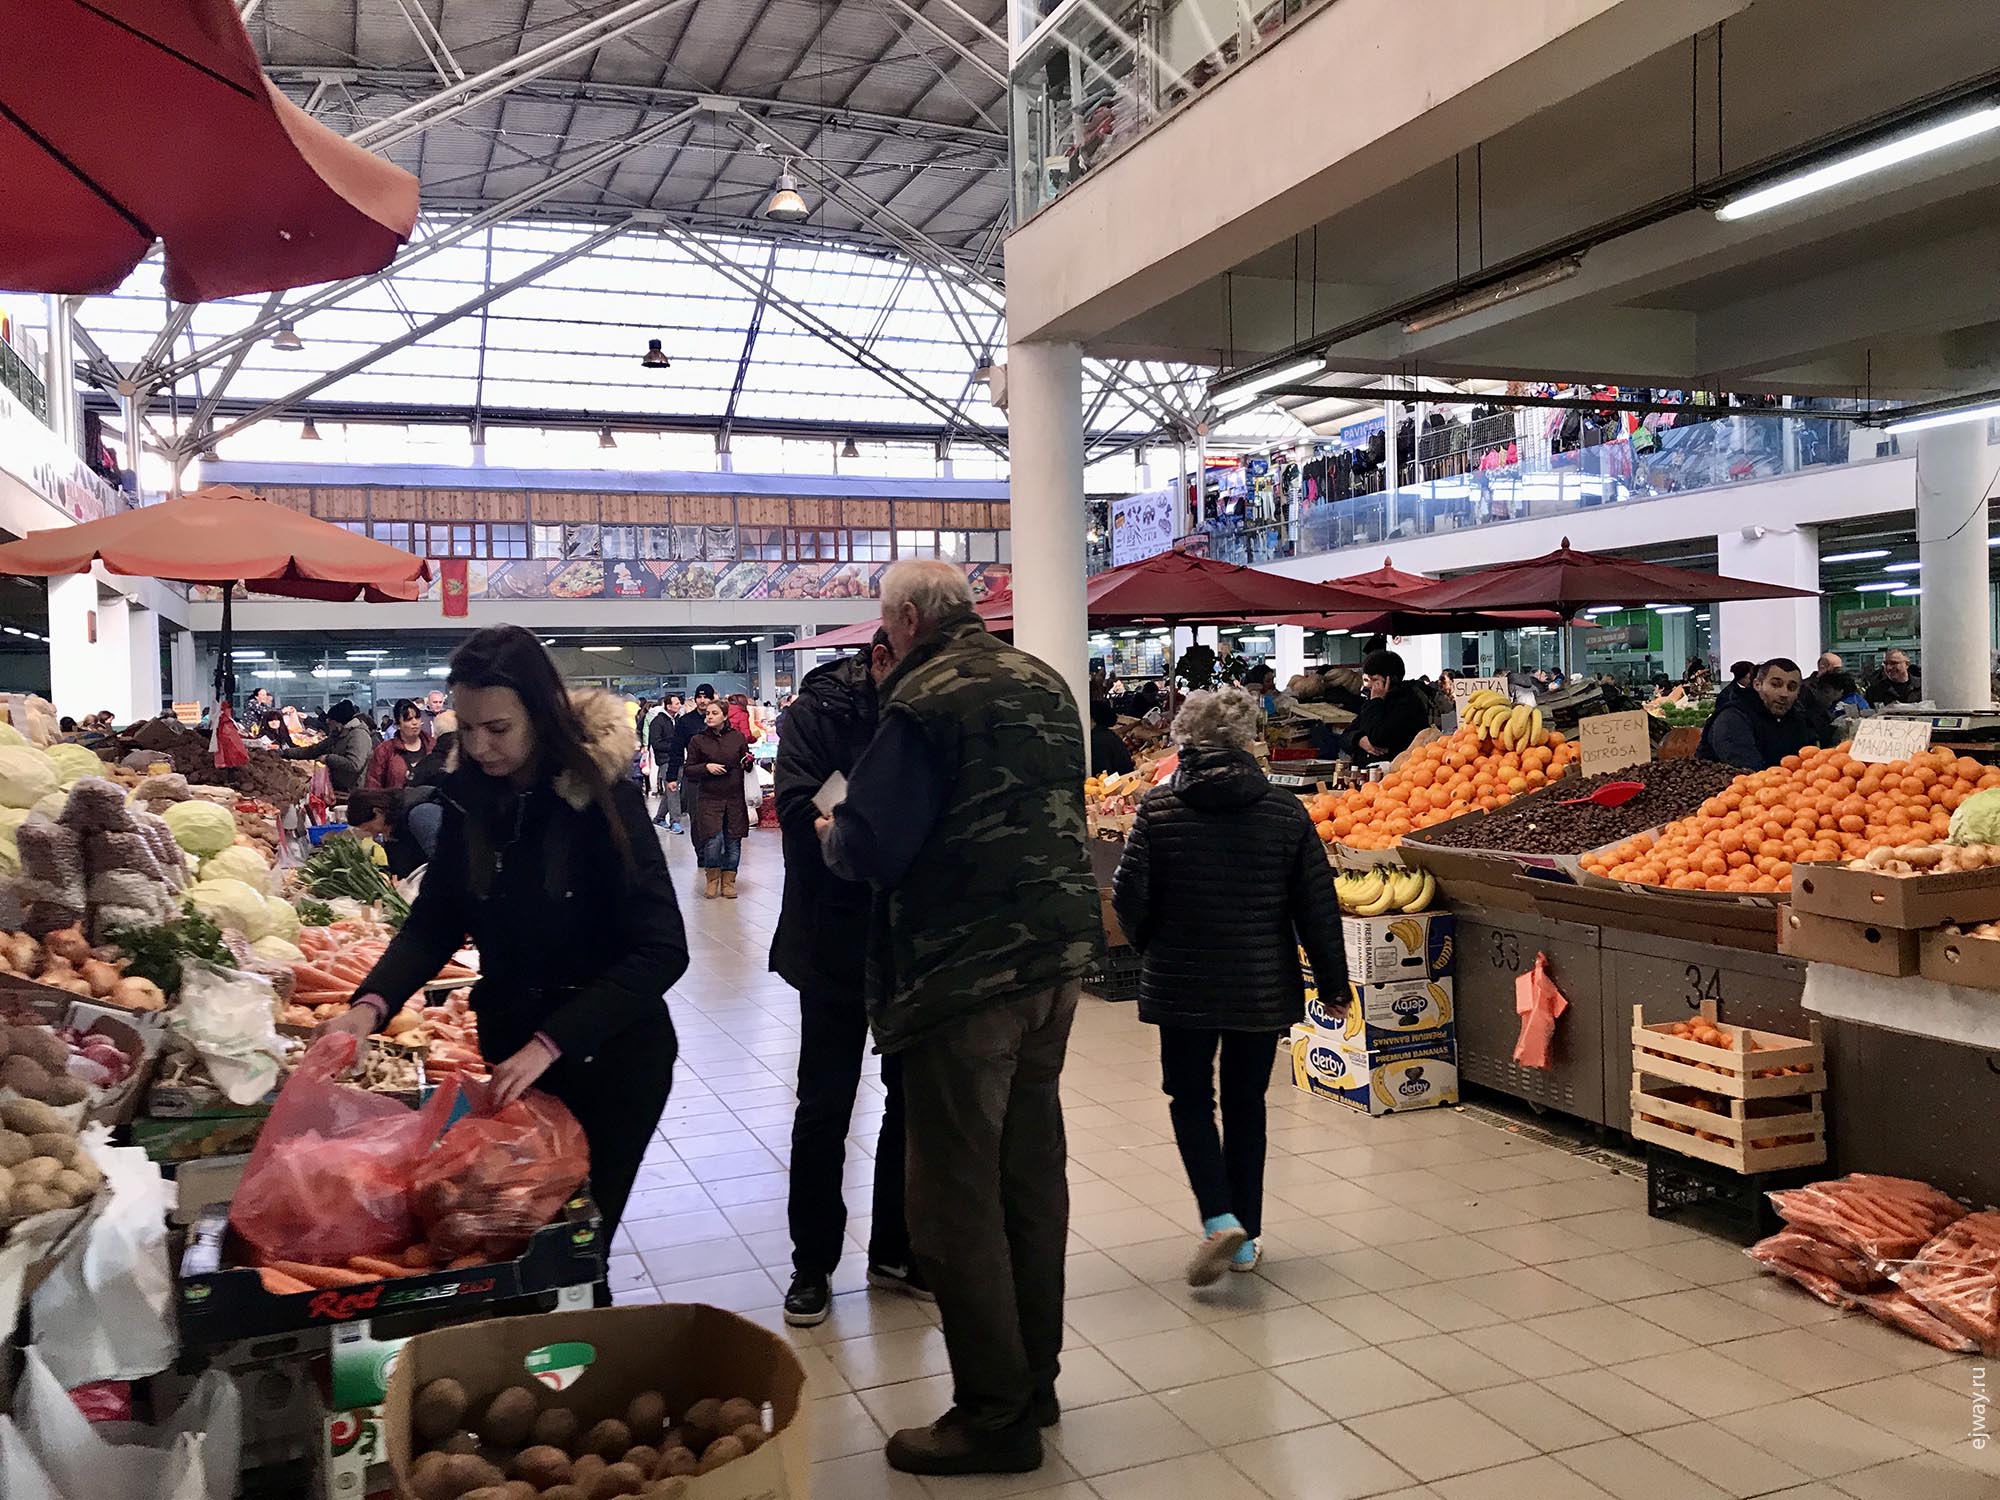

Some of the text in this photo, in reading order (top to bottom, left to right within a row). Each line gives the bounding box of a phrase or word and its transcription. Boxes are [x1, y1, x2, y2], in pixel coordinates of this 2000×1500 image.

[552, 564, 565, 577] PIZZA
[1456, 680, 1504, 697] SLATKA
[1582, 719, 1644, 735] KESTEN
[1860, 720, 1928, 743] BARSKA
[1365, 946, 1373, 979] BANANAS
[1685, 964, 1724, 1010] 34
[1394, 999, 1426, 1012] derby
[1372, 1030, 1448, 1047] PREMIUM BANANAS
[1312, 1047, 1344, 1077] derby
[1375, 1051, 1412, 1063] PREMIUM
[1413, 1046, 1449, 1058] BANANAS
[1400, 1081, 1429, 1094] derby
[309, 1284, 385, 1319] Red
